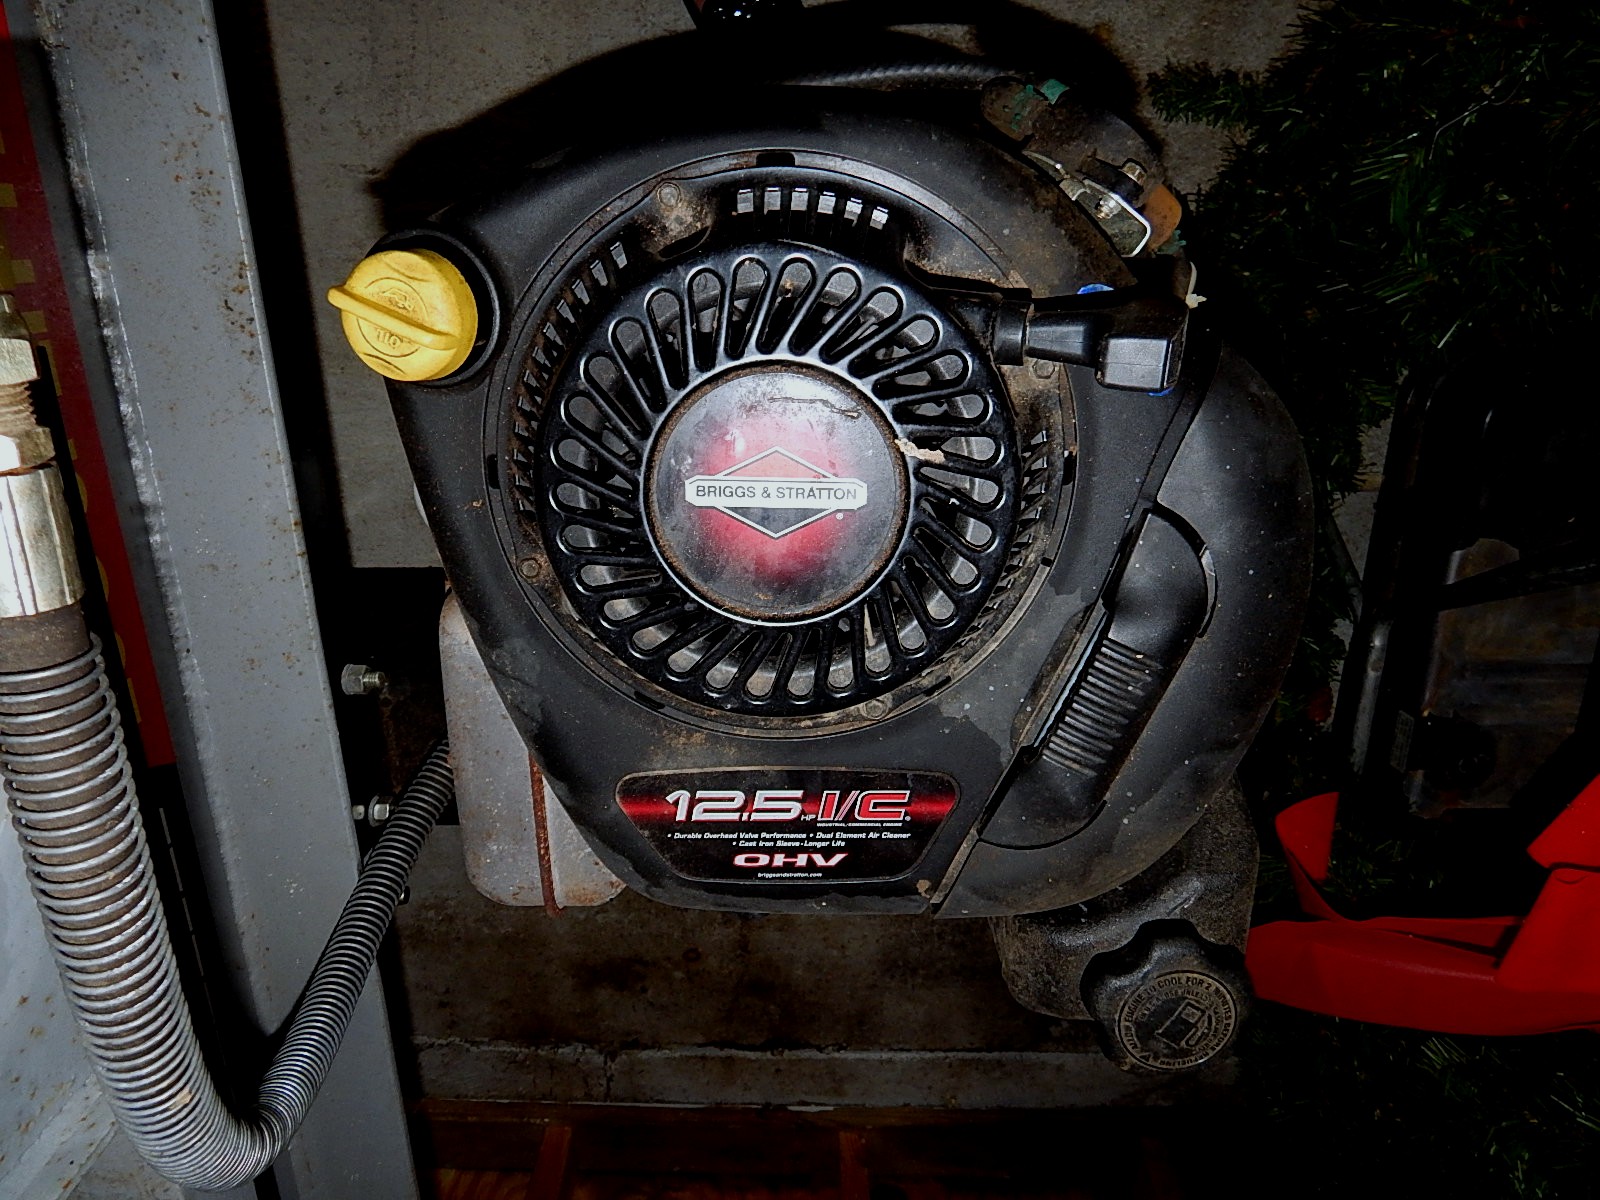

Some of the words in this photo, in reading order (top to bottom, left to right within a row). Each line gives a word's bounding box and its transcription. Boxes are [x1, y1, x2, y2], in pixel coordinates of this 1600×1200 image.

[696, 485, 756, 498] BRIGGS
[761, 487, 771, 499] &
[776, 486, 857, 500] STRATTON
[665, 789, 804, 822] 12.5
[733, 853, 849, 867] OHV
[1157, 977, 1182, 989] COOL
[1186, 976, 1204, 987] FOR
[1205, 982, 1212, 991] 2
[1146, 985, 1157, 994] TO
[1124, 992, 1146, 1023] ENGINE
[1213, 986, 1232, 1020] MINUTES
[1210, 1022, 1232, 1051] BEFORE
